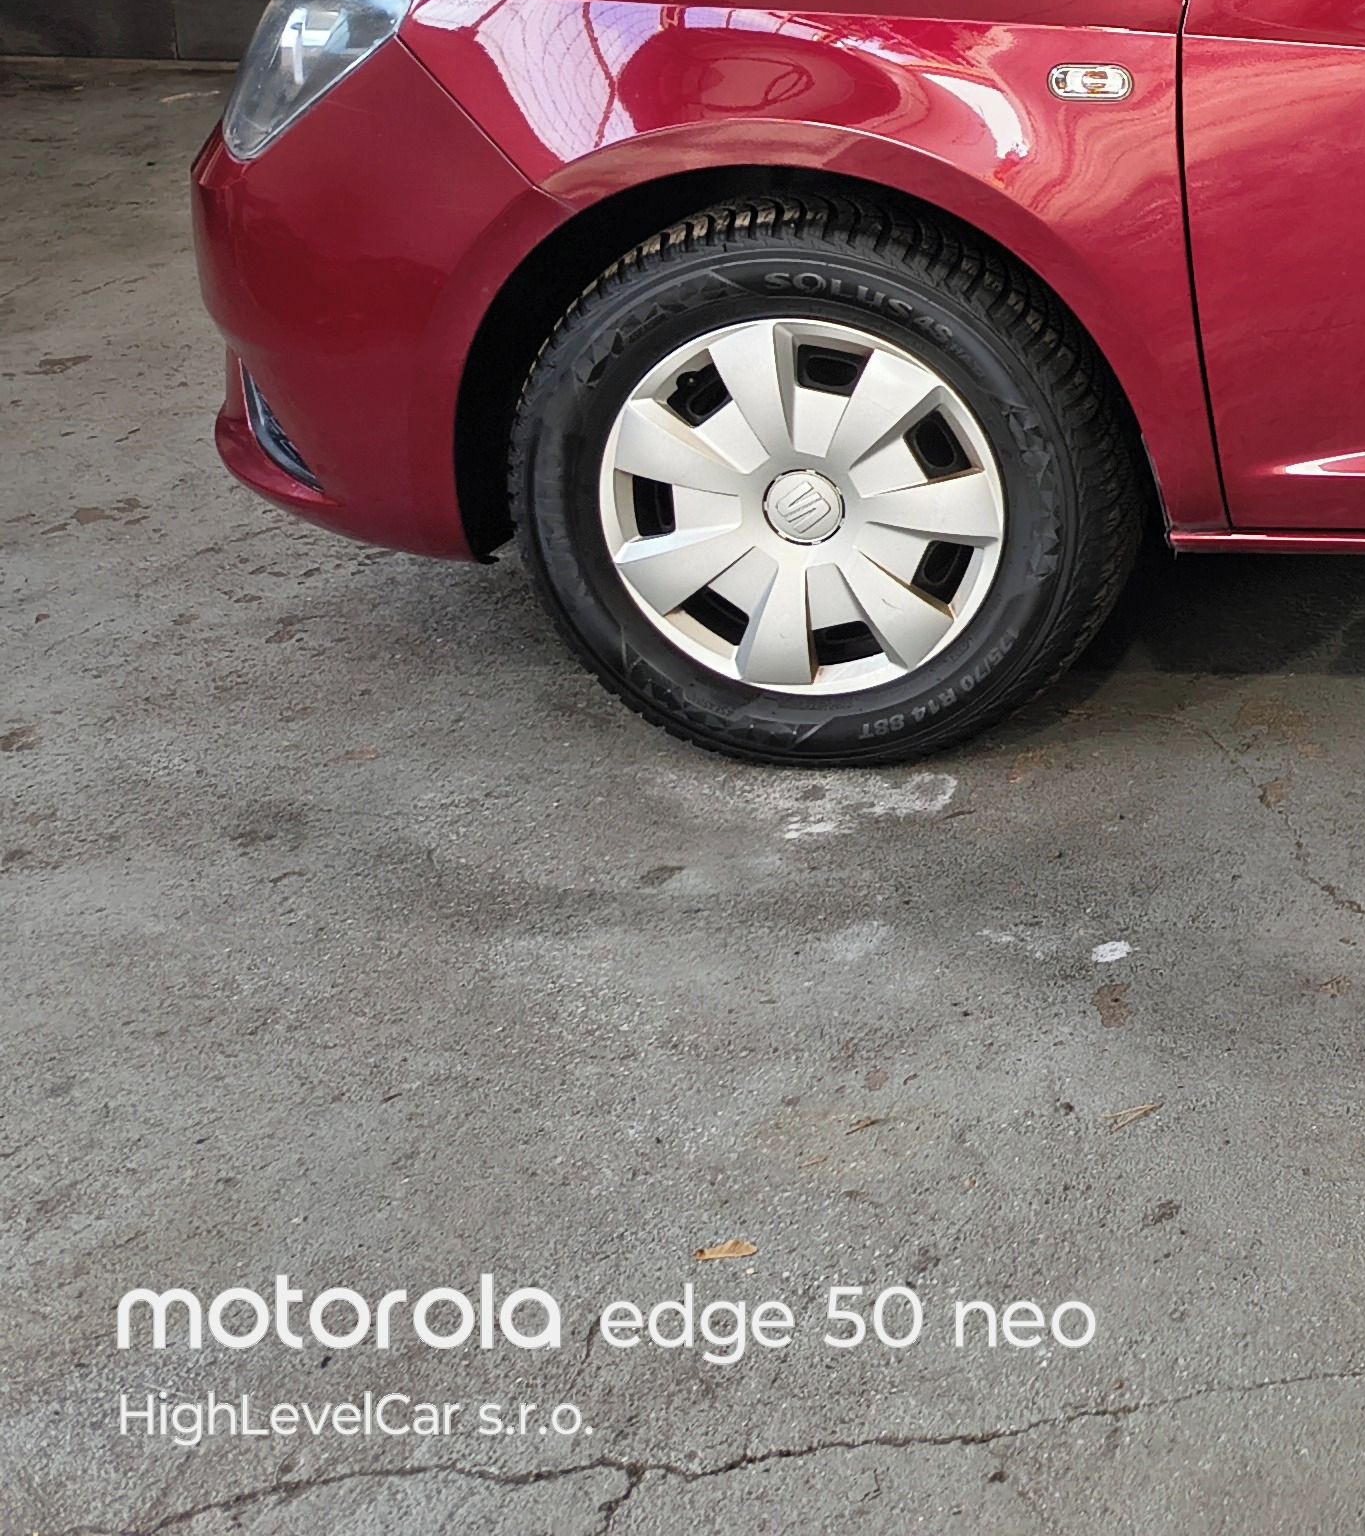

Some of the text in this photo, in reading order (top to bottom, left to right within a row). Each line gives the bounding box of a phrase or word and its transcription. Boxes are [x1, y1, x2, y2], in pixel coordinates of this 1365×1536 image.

[763, 271, 914, 323] SOLUS
[960, 627, 1020, 693] 175/70
[910, 686, 959, 723] R14
